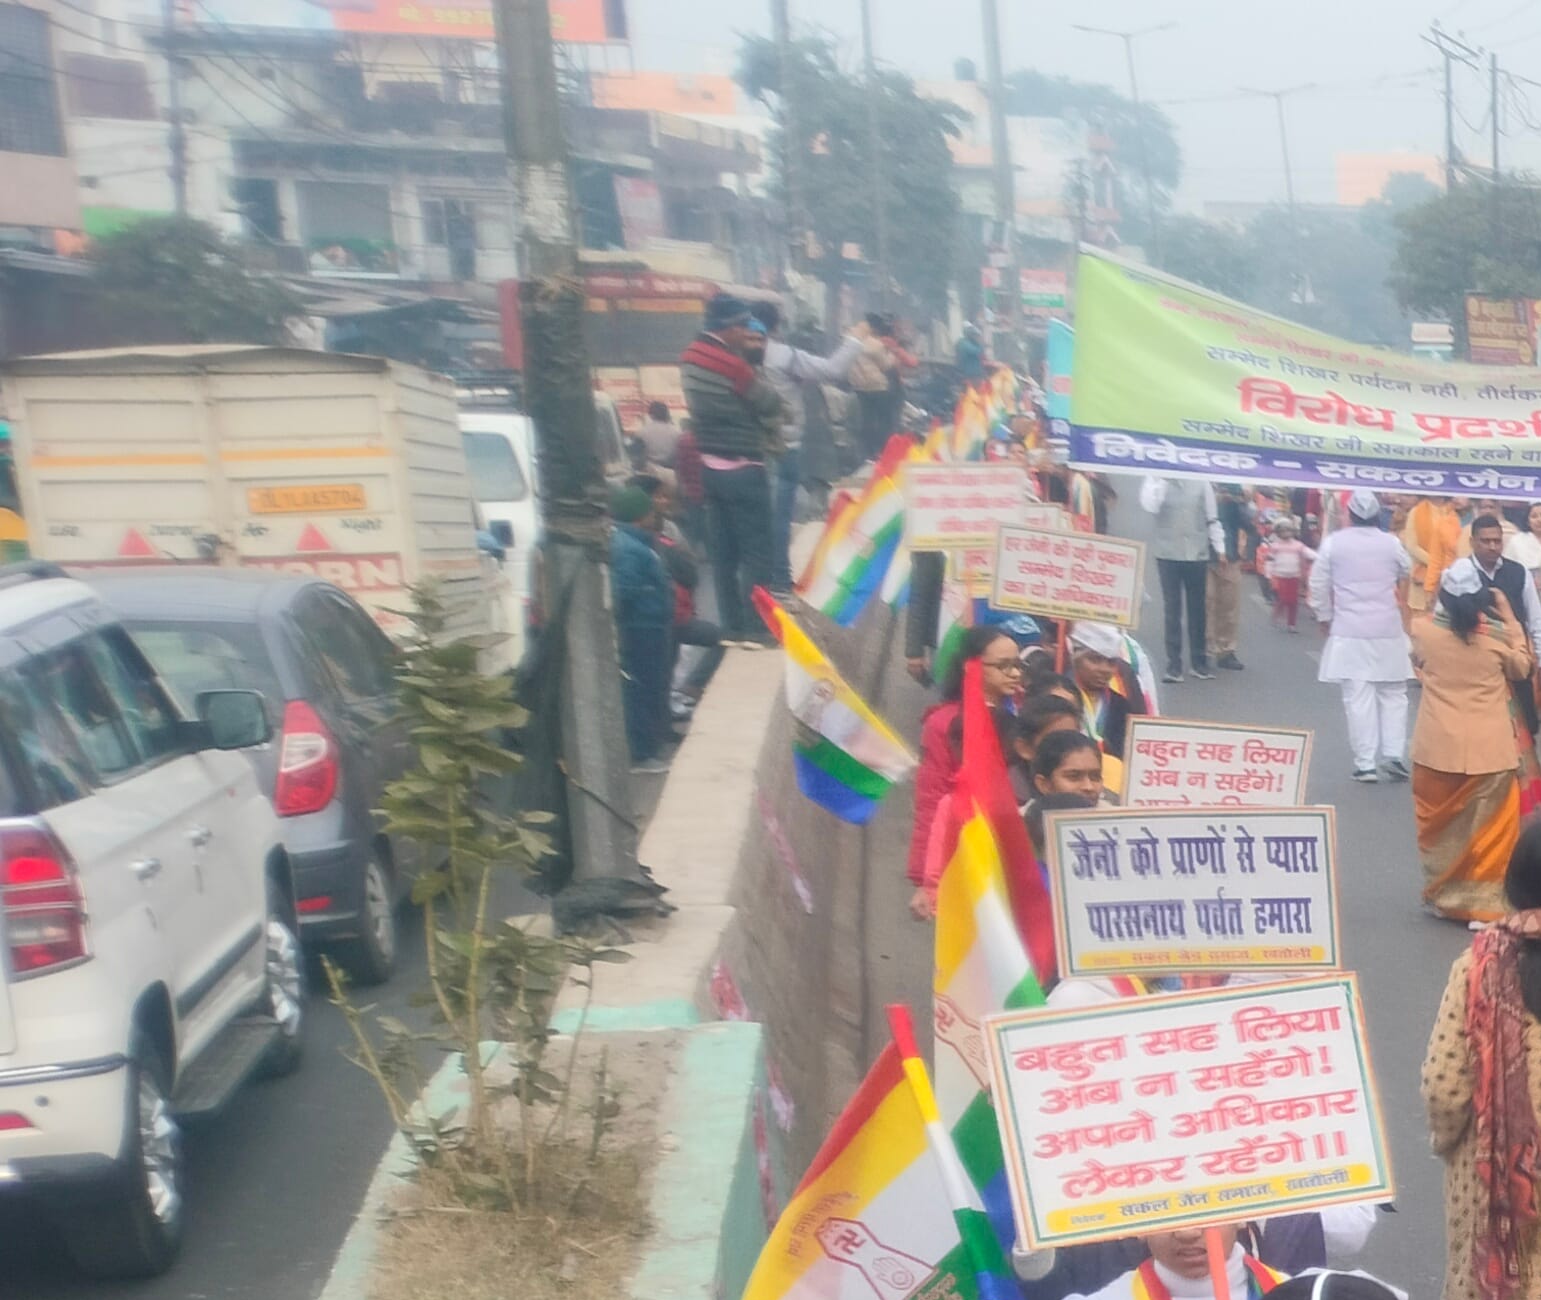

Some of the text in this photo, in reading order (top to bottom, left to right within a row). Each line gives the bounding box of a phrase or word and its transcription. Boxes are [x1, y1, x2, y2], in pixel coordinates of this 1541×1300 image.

[1206, 344, 1270, 371] सम्मेद
[1279, 352, 1339, 383] शिखर
[1350, 370, 1412, 394] पर्यटन
[1238, 377, 1396, 433] विरोध
[1090, 432, 1260, 470] निवेदक
[1314, 459, 1450, 487] सकल
[1455, 465, 1538, 491] जैन
[1181, 417, 1250, 441] सम्मेद
[1260, 424, 1324, 449] शिखर
[1336, 434, 1362, 452] जी
[1469, 445, 1514, 461] रहने
[1136, 738, 1297, 766] बहुत सह लिया
[1140, 770, 1179, 788] अब
[1186, 774, 1206, 787] न
[1068, 824, 1318, 879] जैनों को प्राणों से प्यारा
[1085, 887, 1312, 941] पारसनाथ पर्वत हमारा
[1013, 1005, 1343, 1082] बहुत सह लिया
[1039, 1079, 1124, 1115] अब
[1133, 1071, 1177, 1097] न
[1033, 1094, 1358, 1160] अपने अधिकार
[1058, 1155, 1188, 1200] लेकर
[1119, 1199, 1170, 1218] सकल
